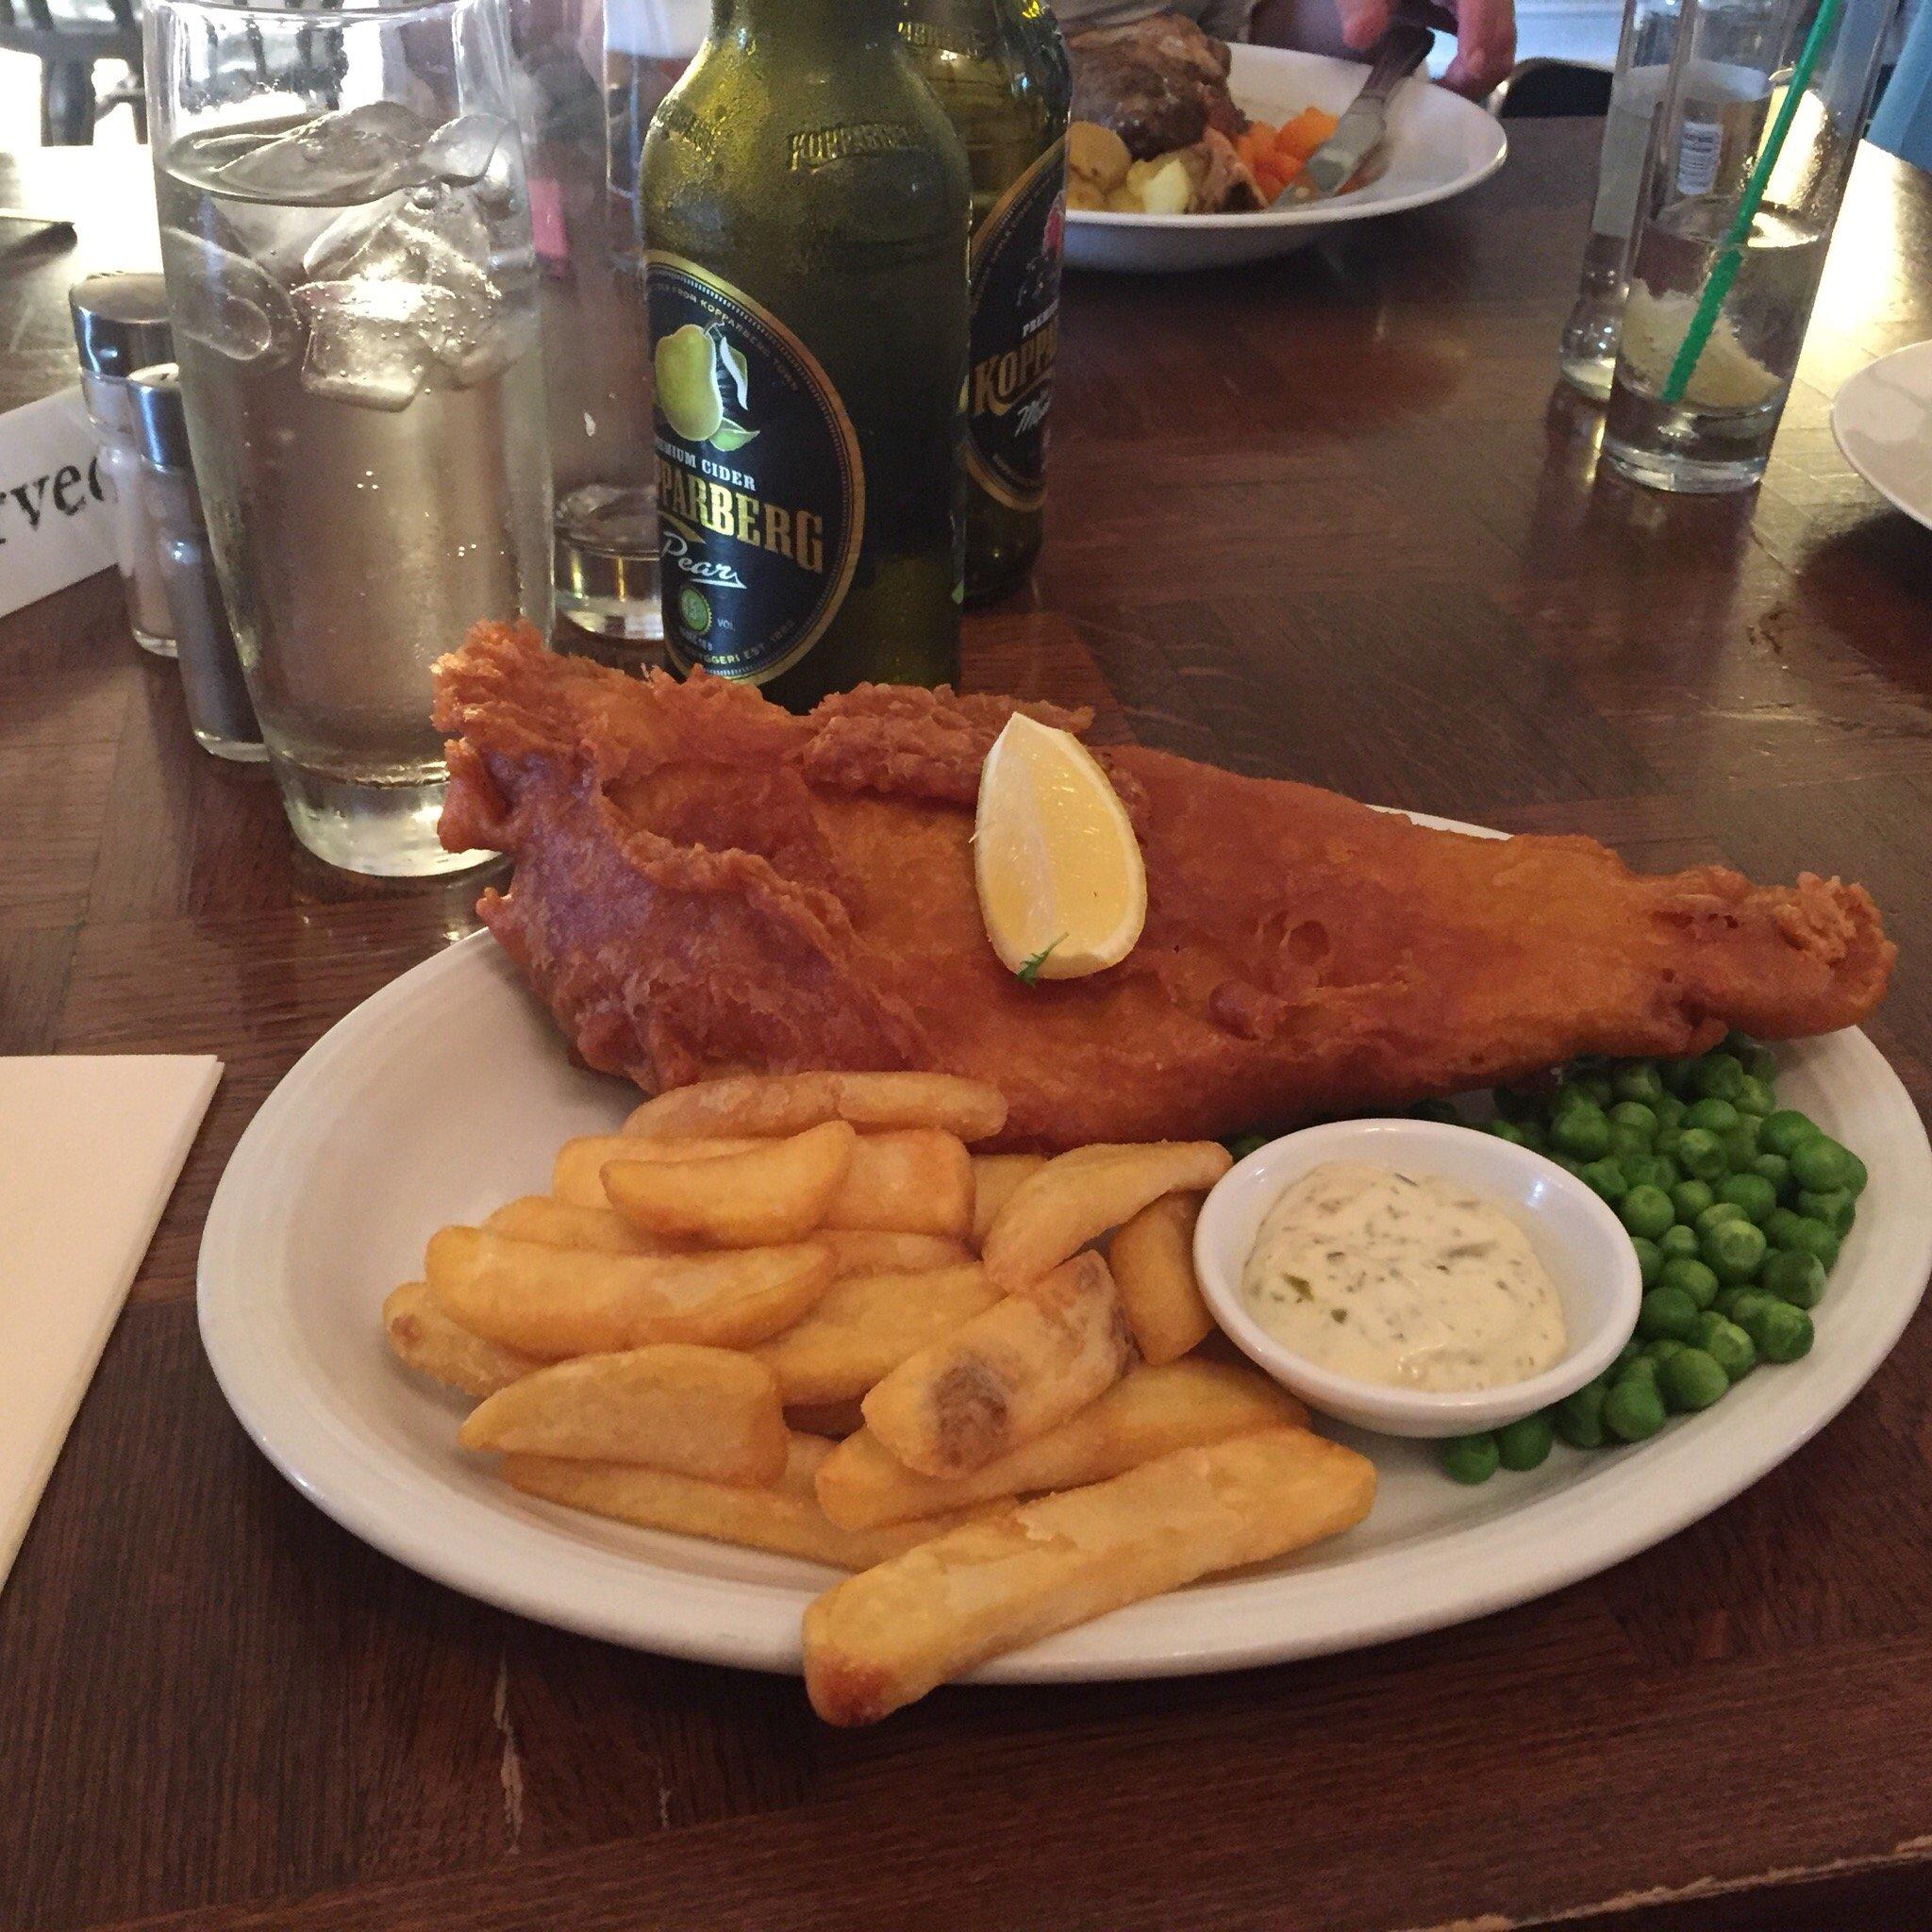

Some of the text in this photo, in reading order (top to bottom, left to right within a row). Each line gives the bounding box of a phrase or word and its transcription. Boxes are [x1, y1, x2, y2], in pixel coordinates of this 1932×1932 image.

[701, 458, 757, 491] CIDER
[660, 461, 823, 574] PARBERG
[661, 530, 747, 590] Pear
